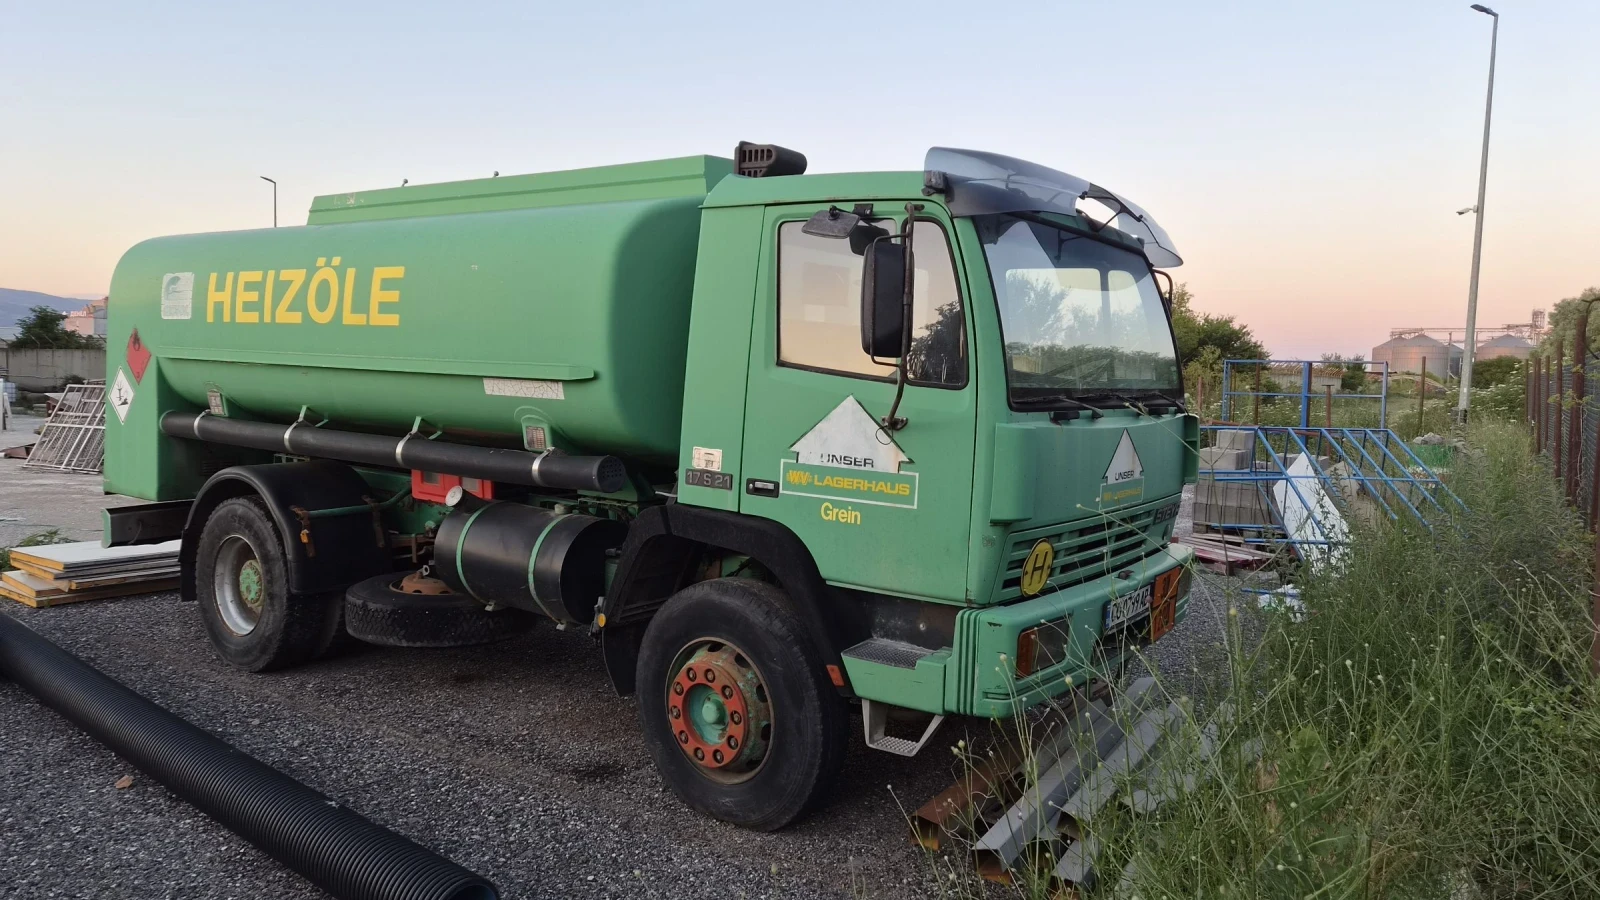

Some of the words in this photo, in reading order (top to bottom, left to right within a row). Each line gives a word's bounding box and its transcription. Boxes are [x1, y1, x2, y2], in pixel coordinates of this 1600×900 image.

[206, 256, 405, 326] HEIZÖLE
[687, 470, 701, 484] 17
[714, 474, 731, 489] 21
[813, 474, 911, 496] LAGERHAUS
[1114, 470, 1135, 481] UNSER
[820, 502, 862, 525] Grein
[1028, 551, 1049, 587] H
